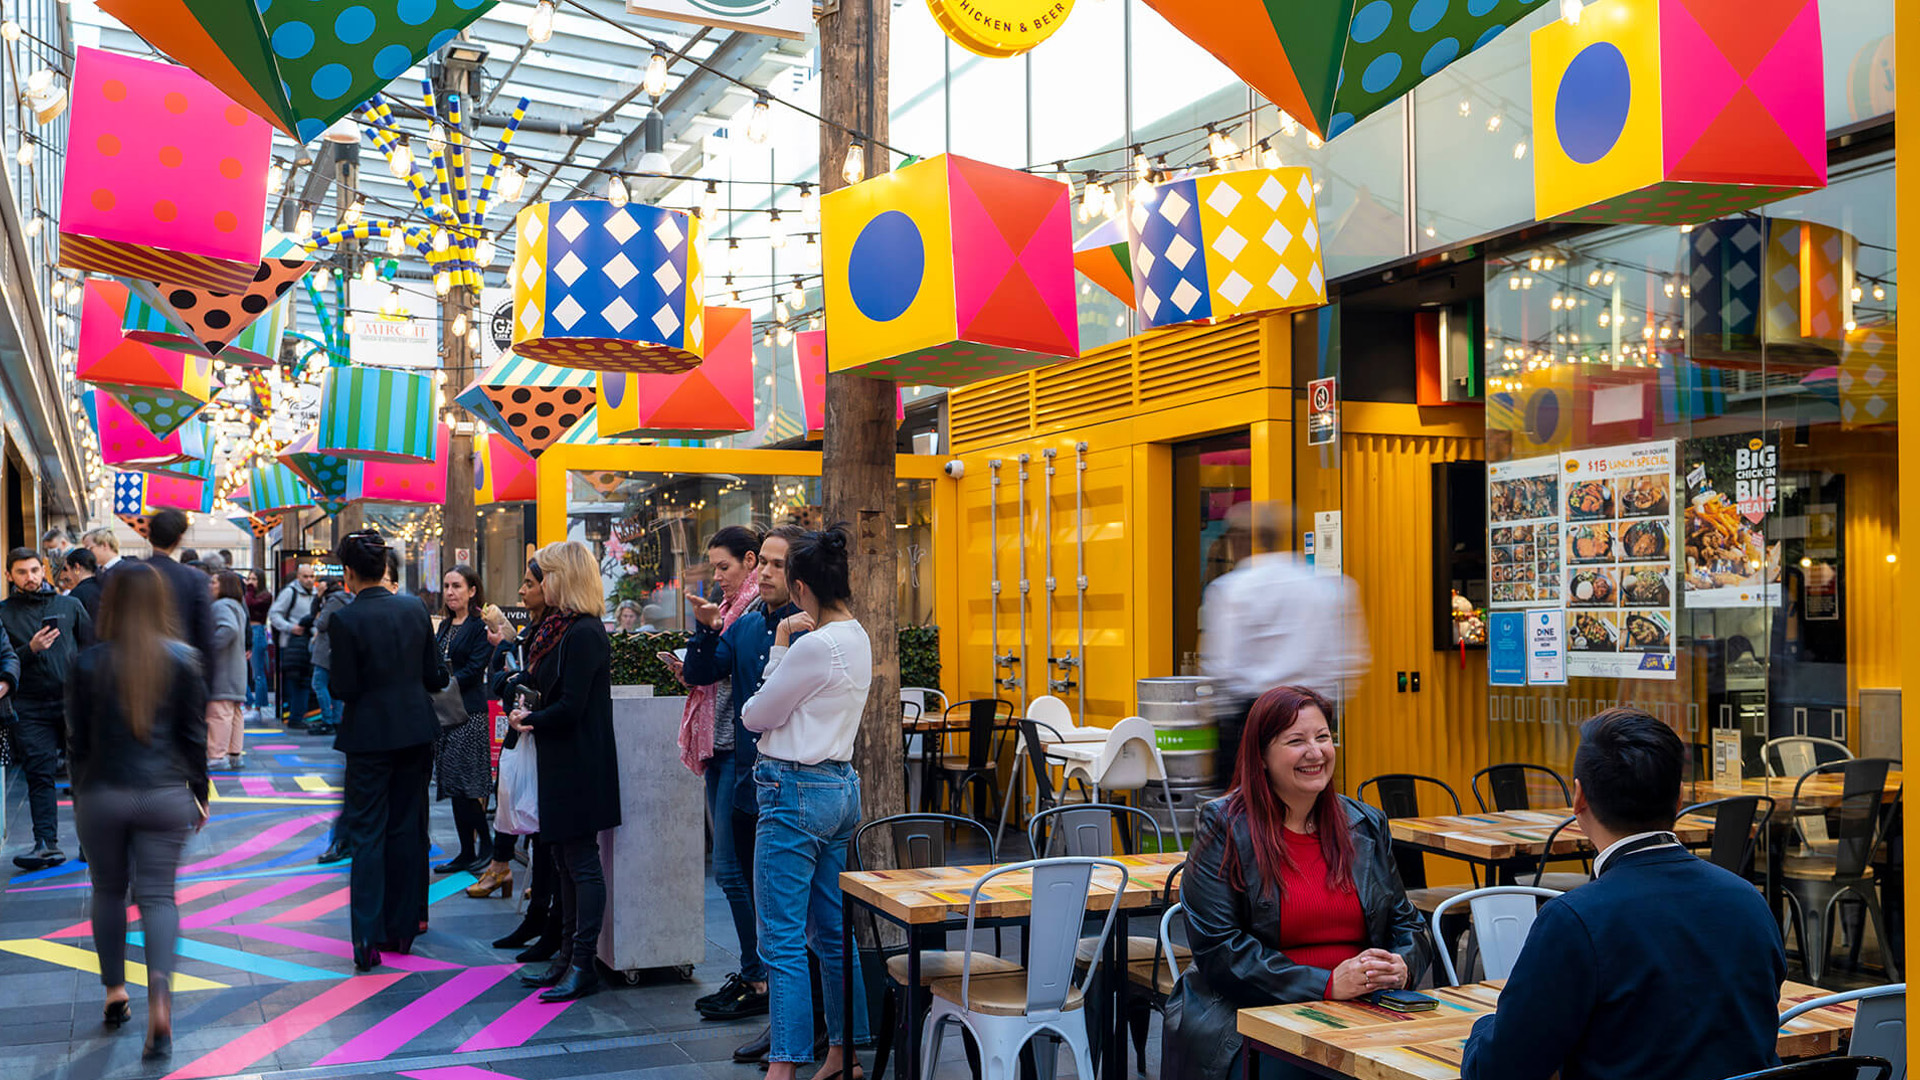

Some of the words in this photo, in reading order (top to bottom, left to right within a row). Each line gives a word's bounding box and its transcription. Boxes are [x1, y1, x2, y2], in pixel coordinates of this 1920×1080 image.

[956, 0, 1011, 32] HICKEN
[1019, 22, 1028, 32] &
[1033, 2, 1065, 29] BEER
[1588, 459, 1607, 472] $15
[1736, 467, 1776, 479] CHICKEN
[1736, 478, 1776, 502] BIG
